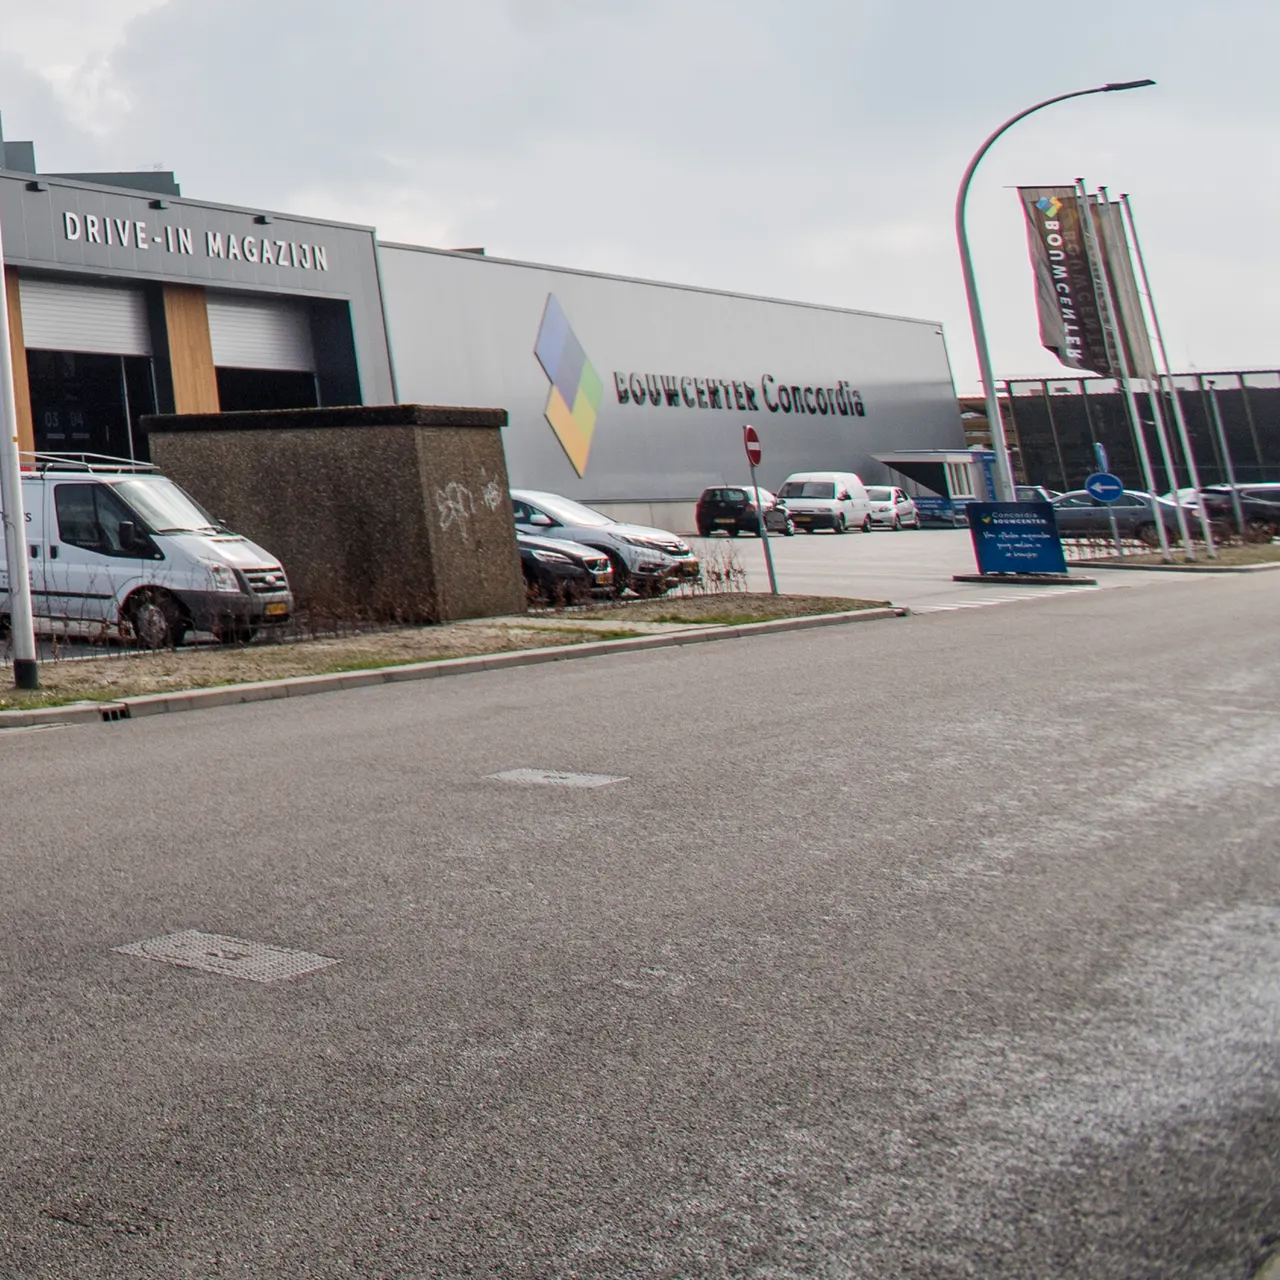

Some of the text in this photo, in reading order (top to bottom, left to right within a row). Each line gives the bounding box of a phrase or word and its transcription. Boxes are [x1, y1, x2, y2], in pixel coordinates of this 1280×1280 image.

[63, 211, 329, 271] DRIVE-IN MAGAZIJN
[613, 371, 866, 417] BOUWCENTER Concordia
[991, 511, 1038, 519] Concordia
